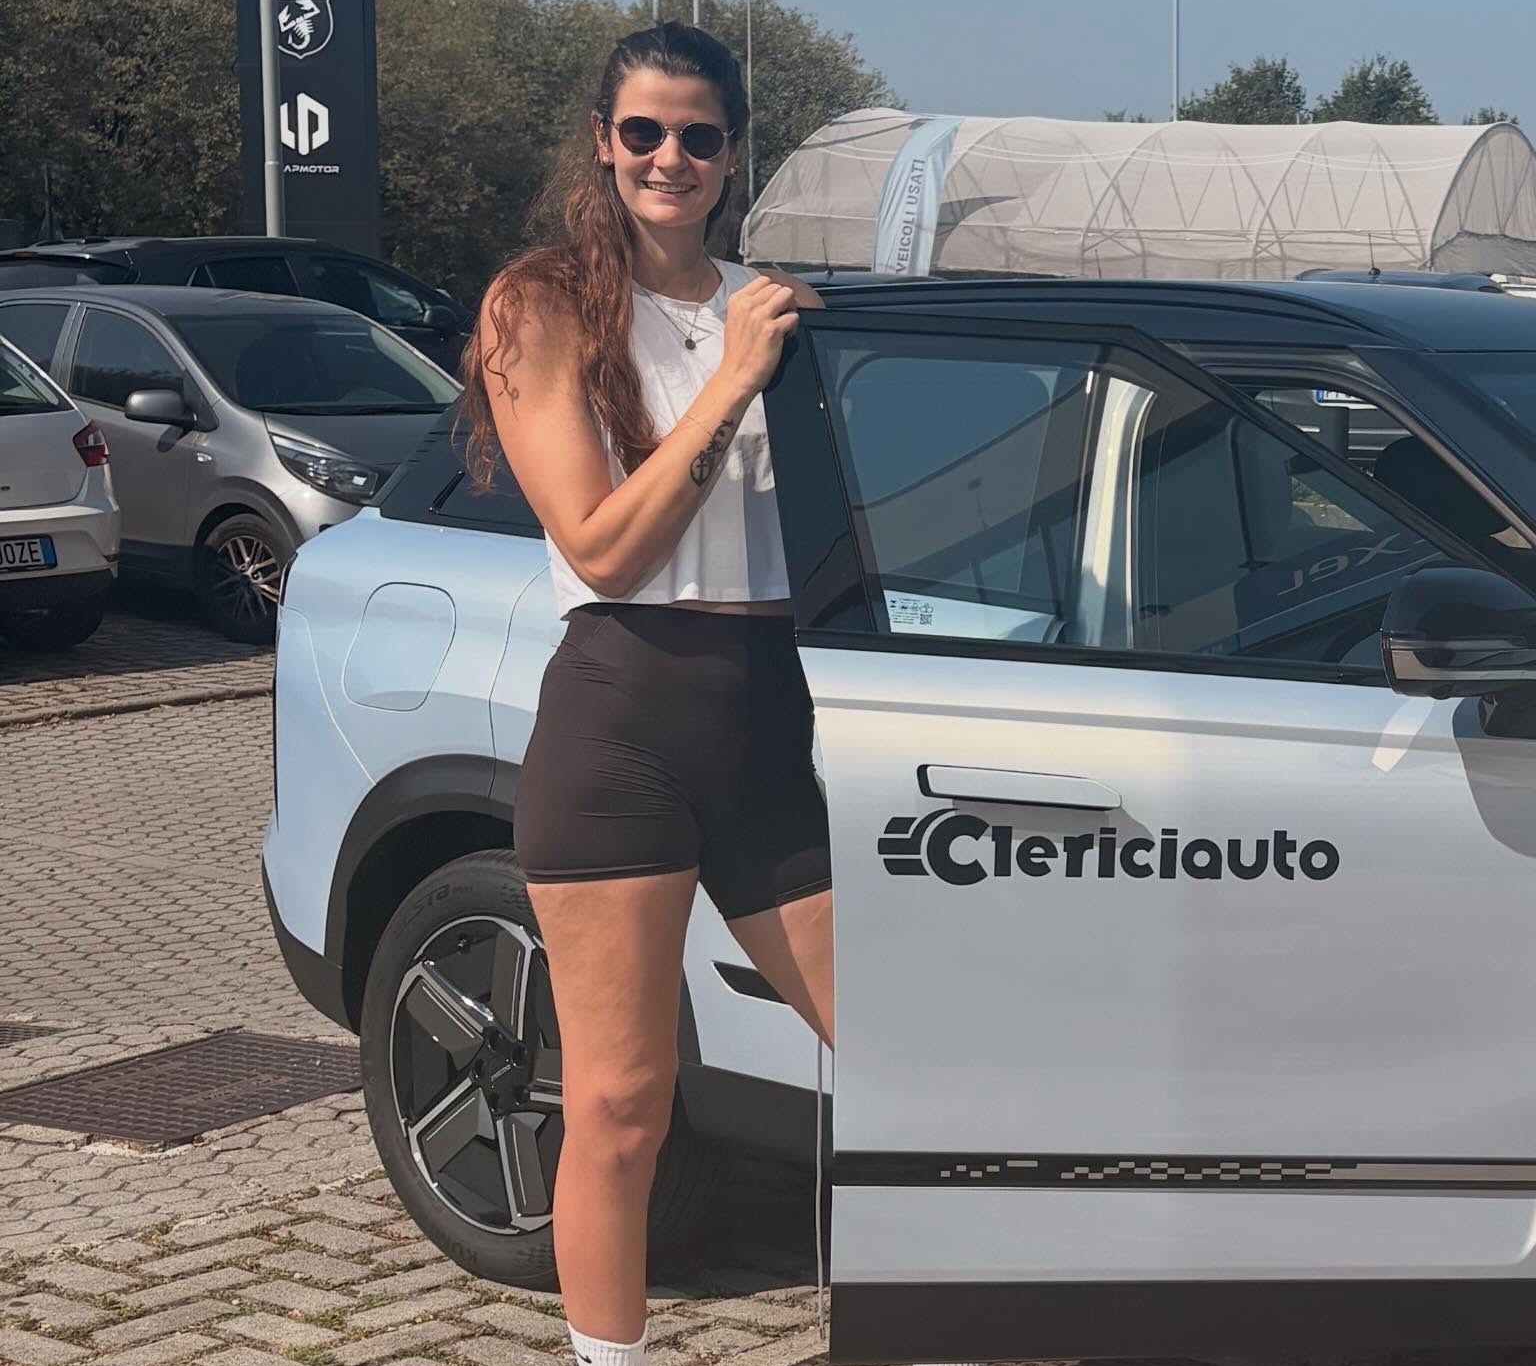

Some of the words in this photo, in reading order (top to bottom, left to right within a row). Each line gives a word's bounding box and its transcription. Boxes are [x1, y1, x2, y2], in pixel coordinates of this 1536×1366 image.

[283, 164, 340, 174] APMOTOR
[905, 158, 926, 205] USATI
[896, 211, 915, 274] VEICOLI
[925, 812, 1340, 886] Clericiauto
